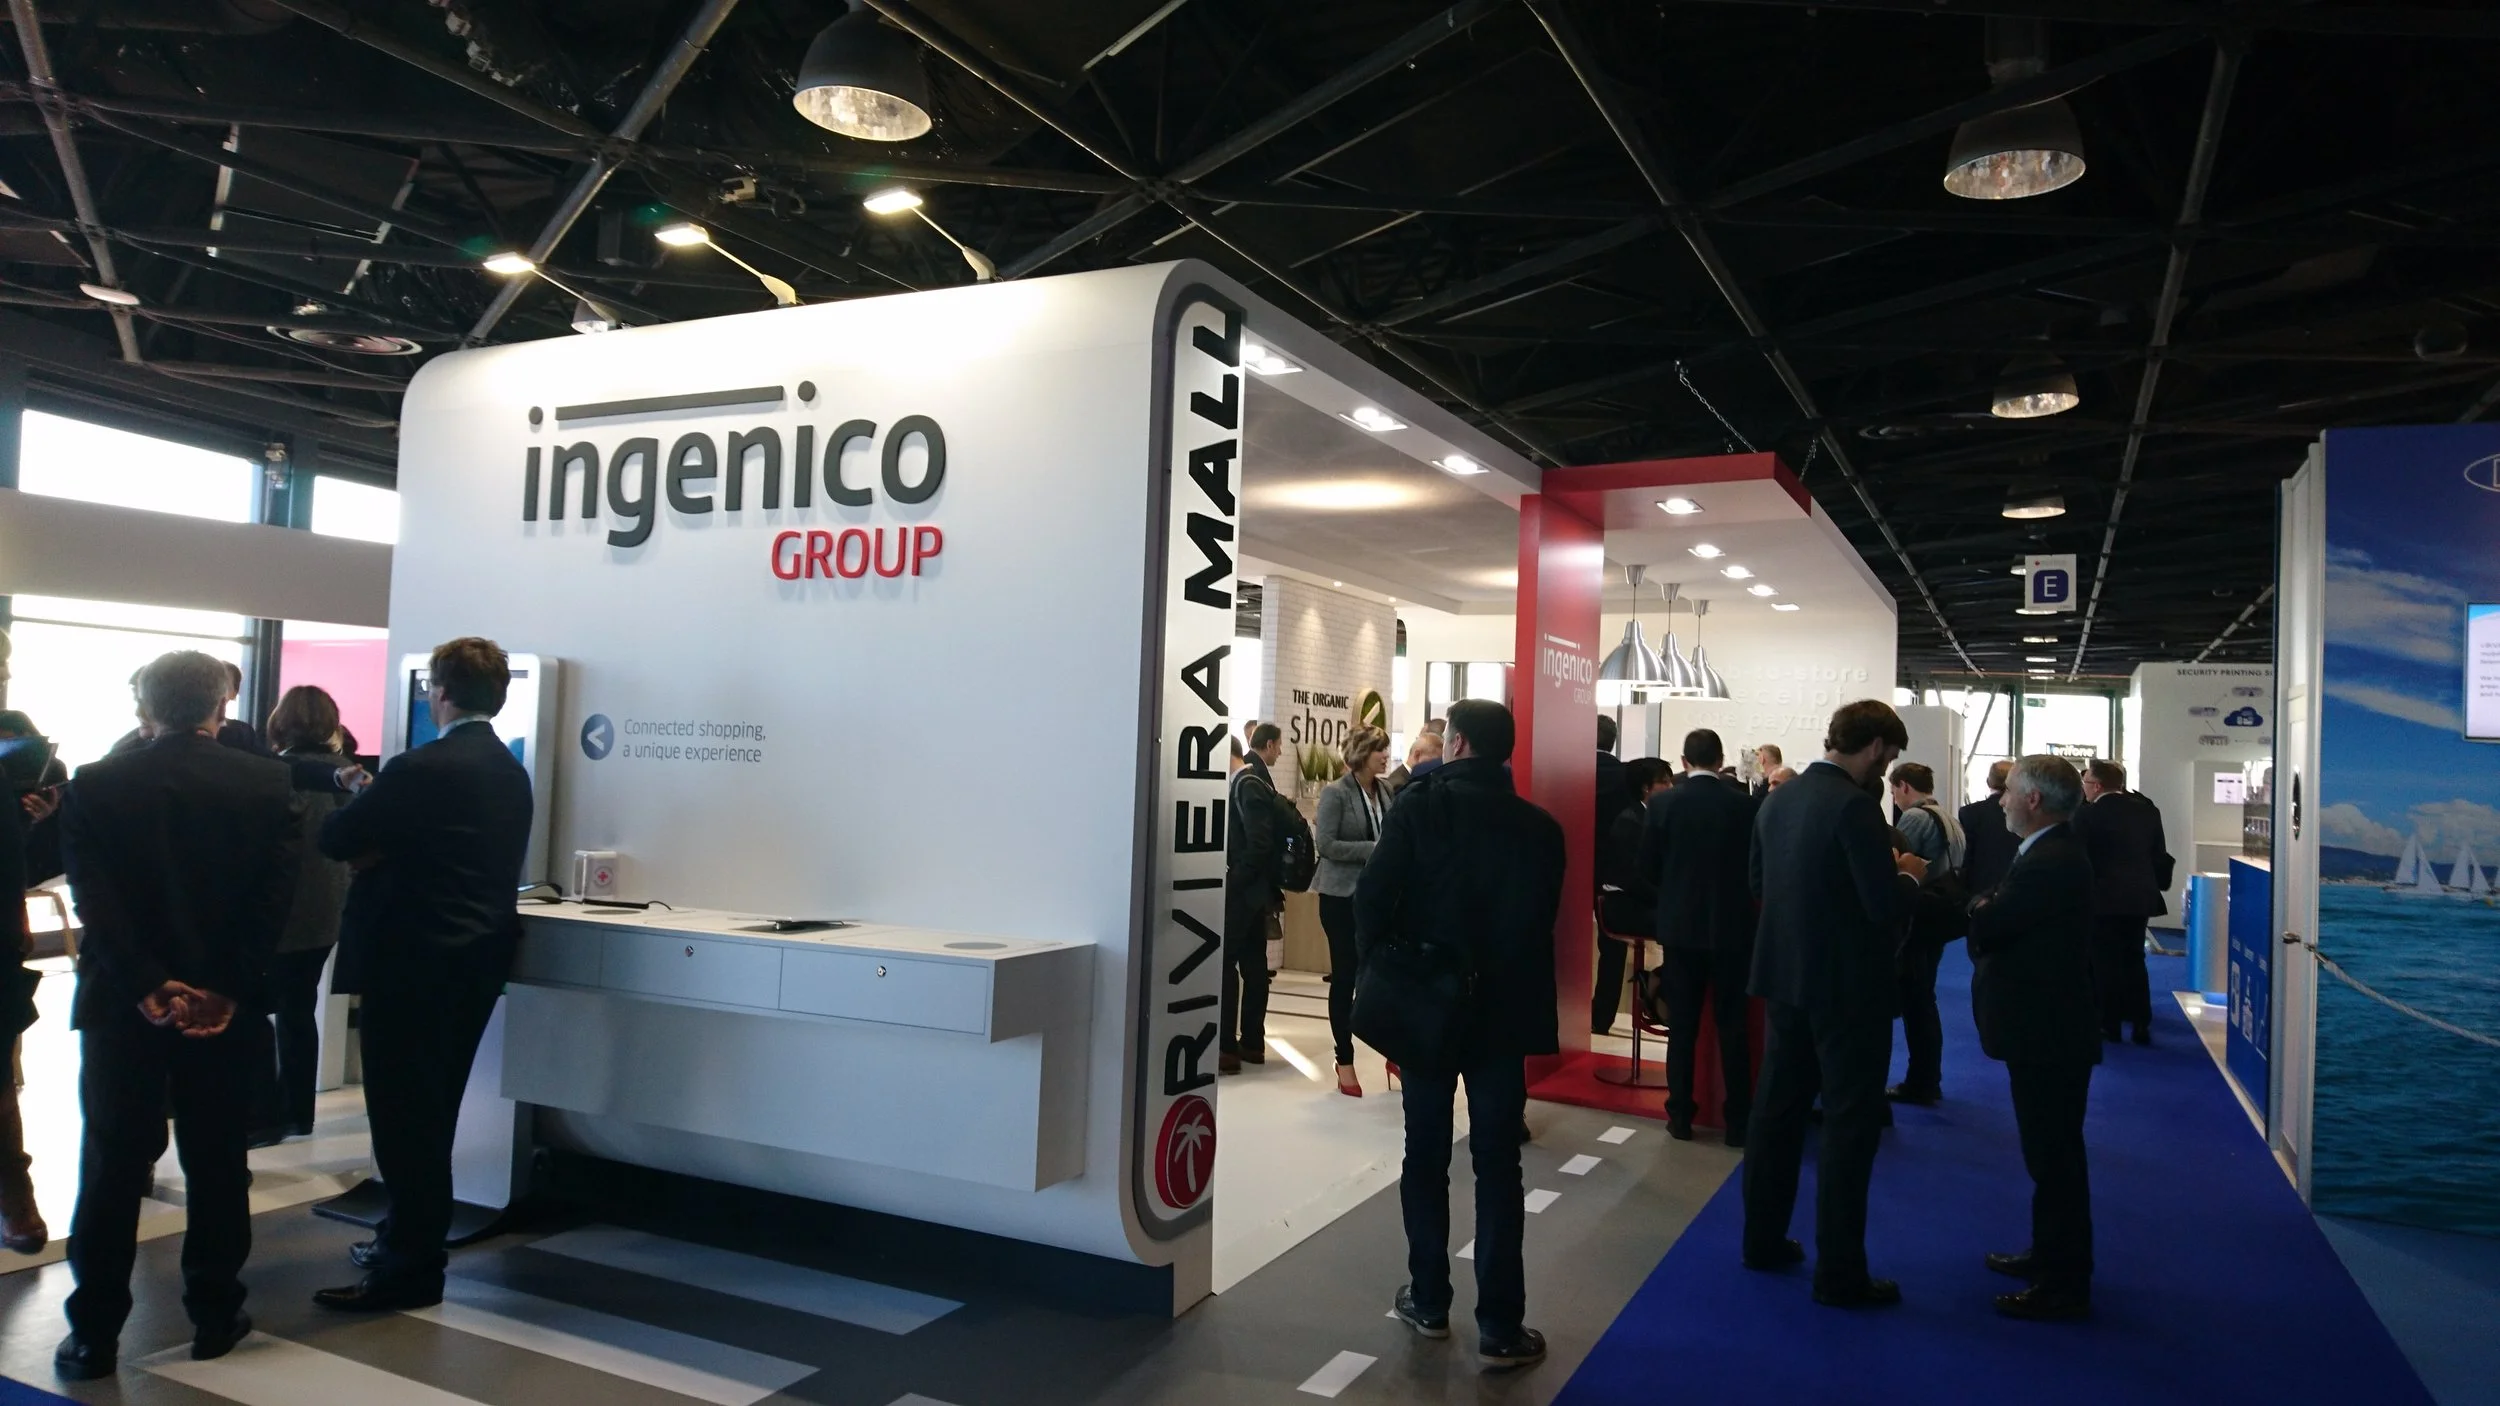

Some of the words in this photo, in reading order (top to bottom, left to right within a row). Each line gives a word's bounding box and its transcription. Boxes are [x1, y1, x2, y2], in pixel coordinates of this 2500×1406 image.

[523, 380, 946, 548] ingenico
[1184, 310, 1242, 609] MALL
[771, 525, 943, 581] GROUP
[2043, 575, 2058, 598] E
[1543, 632, 1593, 689] ingenico
[2177, 668, 2219, 677] SECURITY
[2220, 669, 2263, 677] PRINTING
[1292, 689, 1311, 705] THE
[1312, 692, 1350, 710] ORGANIC
[1733, 685, 1848, 707] eceipt
[624, 718, 694, 736] Connected
[699, 720, 767, 741] shopping,
[622, 744, 630, 758] a
[635, 742, 681, 761] unique
[685, 744, 762, 763] experience
[1164, 645, 1231, 1097] RIVIERA
